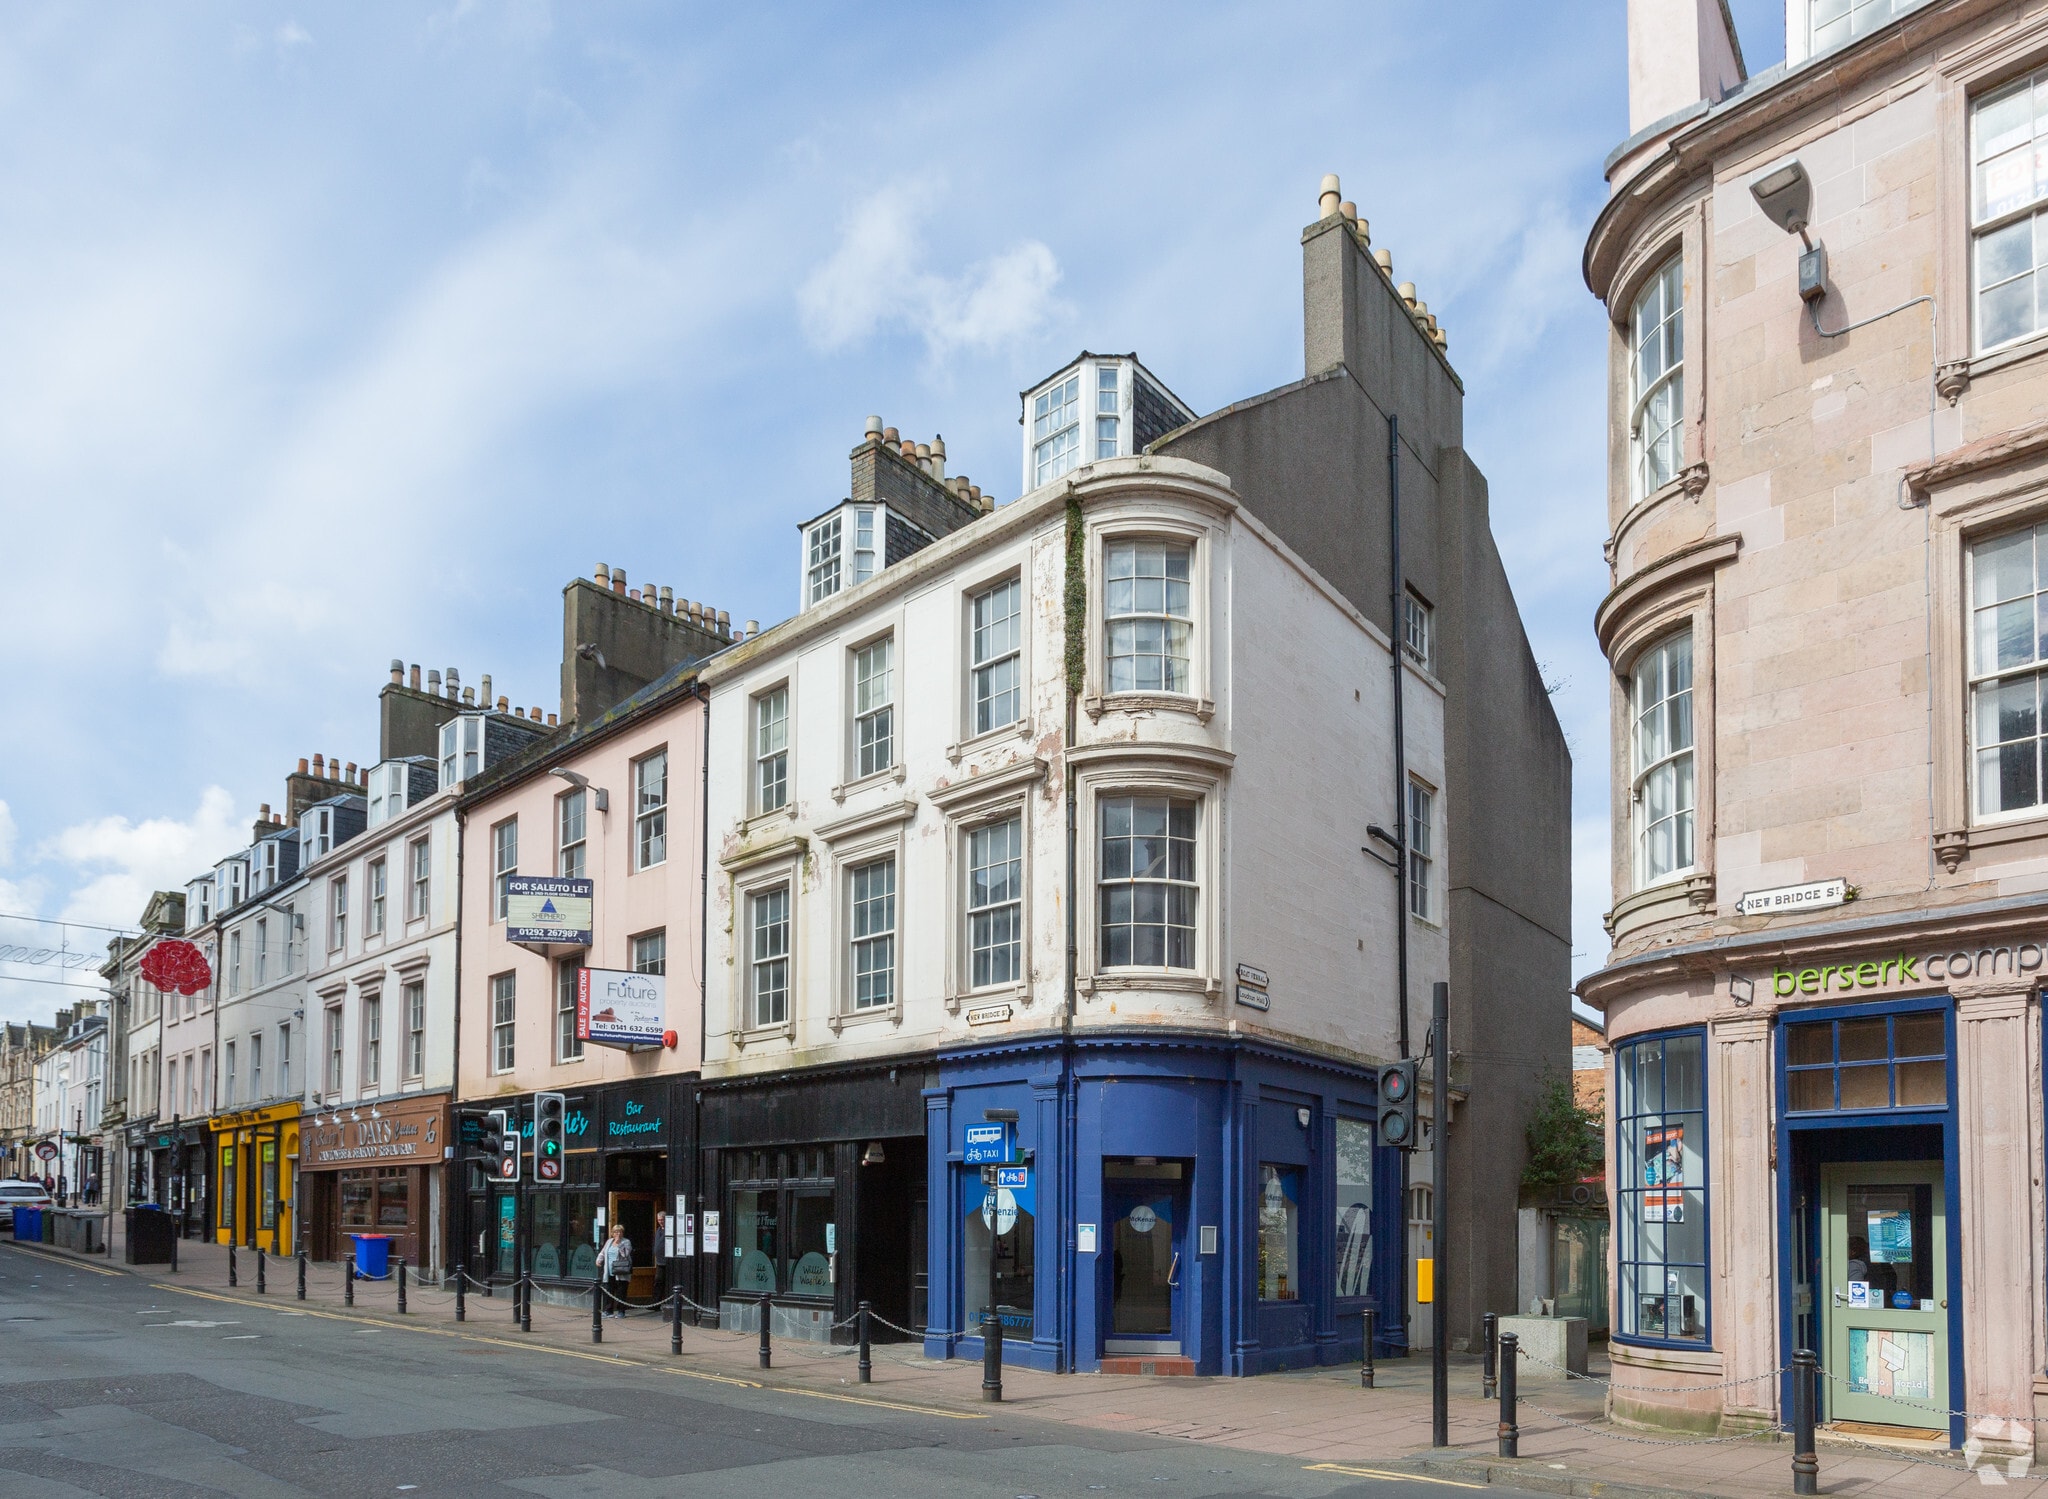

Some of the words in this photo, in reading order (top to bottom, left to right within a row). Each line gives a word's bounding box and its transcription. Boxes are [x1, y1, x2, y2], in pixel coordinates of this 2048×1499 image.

[509, 882, 528, 890] FOR
[530, 883, 570, 892] SALE/TO
[572, 885, 589, 893] LET
[1747, 897, 1770, 909] NEW
[1775, 890, 1821, 905] BRIDGE
[531, 912, 567, 920] SHEPHERD
[519, 928, 544, 936] 01292
[547, 929, 578, 937] 267987
[1773, 952, 1920, 995] berserk
[1924, 943, 2048, 978] comp
[607, 981, 657, 1000] Future
[599, 998, 627, 1007] property
[580, 1007, 588, 1016] by
[982, 1010, 1000, 1019] BRIDGE
[579, 1019, 587, 1037] SALE
[626, 1100, 644, 1115] Bar
[358, 1119, 392, 1146] DAYS
[609, 1117, 662, 1136] Restaurant
[380, 1143, 417, 1156] RESTAURANT
[983, 1149, 999, 1158] TAXI
[982, 1206, 1019, 1216] Mcenzie
[998, 1314, 1033, 1328] 86777
[1858, 1376, 1889, 1387] Hello,
[1895, 1380, 1928, 1389] World!
